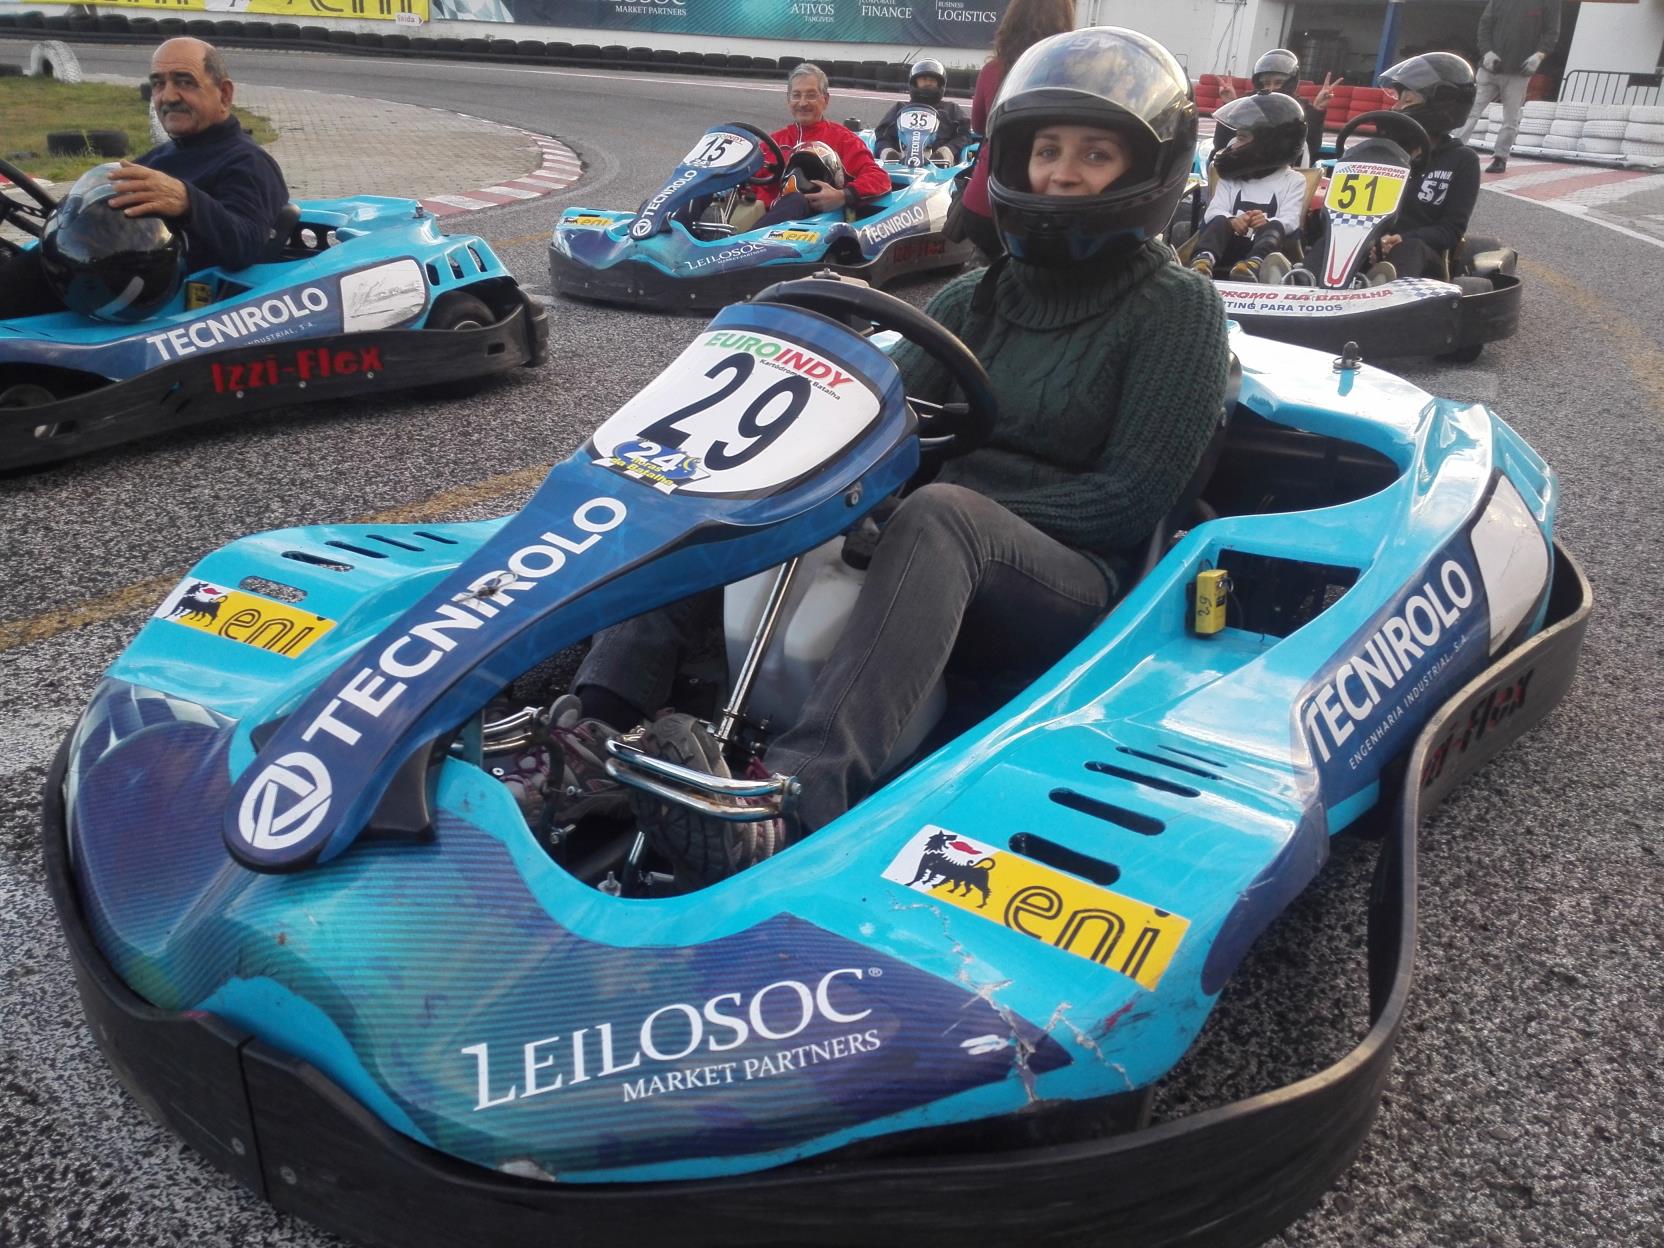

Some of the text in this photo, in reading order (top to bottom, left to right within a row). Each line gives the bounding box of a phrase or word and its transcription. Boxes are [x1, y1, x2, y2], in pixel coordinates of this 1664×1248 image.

[615, 5, 687, 16] MARKET PARTNERS
[791, 3, 834, 15] ATIVOS
[862, 5, 913, 19] FINANCE
[938, 9, 997, 23] LOGISTICS
[910, 113, 928, 127] 35
[698, 136, 733, 162] 15
[1337, 174, 1380, 212] 51
[862, 206, 925, 245] TECNIROLO
[1260, 303, 1294, 312] PARA
[1298, 303, 1344, 312] TODOS
[1284, 293, 1311, 301] DA
[1315, 289, 1394, 302] BATALHA
[146, 287, 329, 361] TECNIROLO
[704, 332, 854, 390] EUROINDY
[812, 381, 841, 401] Batalha
[637, 352, 812, 471] 29
[624, 441, 687, 472] 24
[218, 607, 327, 656] eni
[302, 497, 628, 747] TECNIROLO
[1305, 560, 1473, 763] TECNIROLO
[1349, 706, 1404, 771] ENGENHARIA
[1002, 885, 1172, 980] eni
[622, 1029, 882, 1103] MARKET PARTNERS
